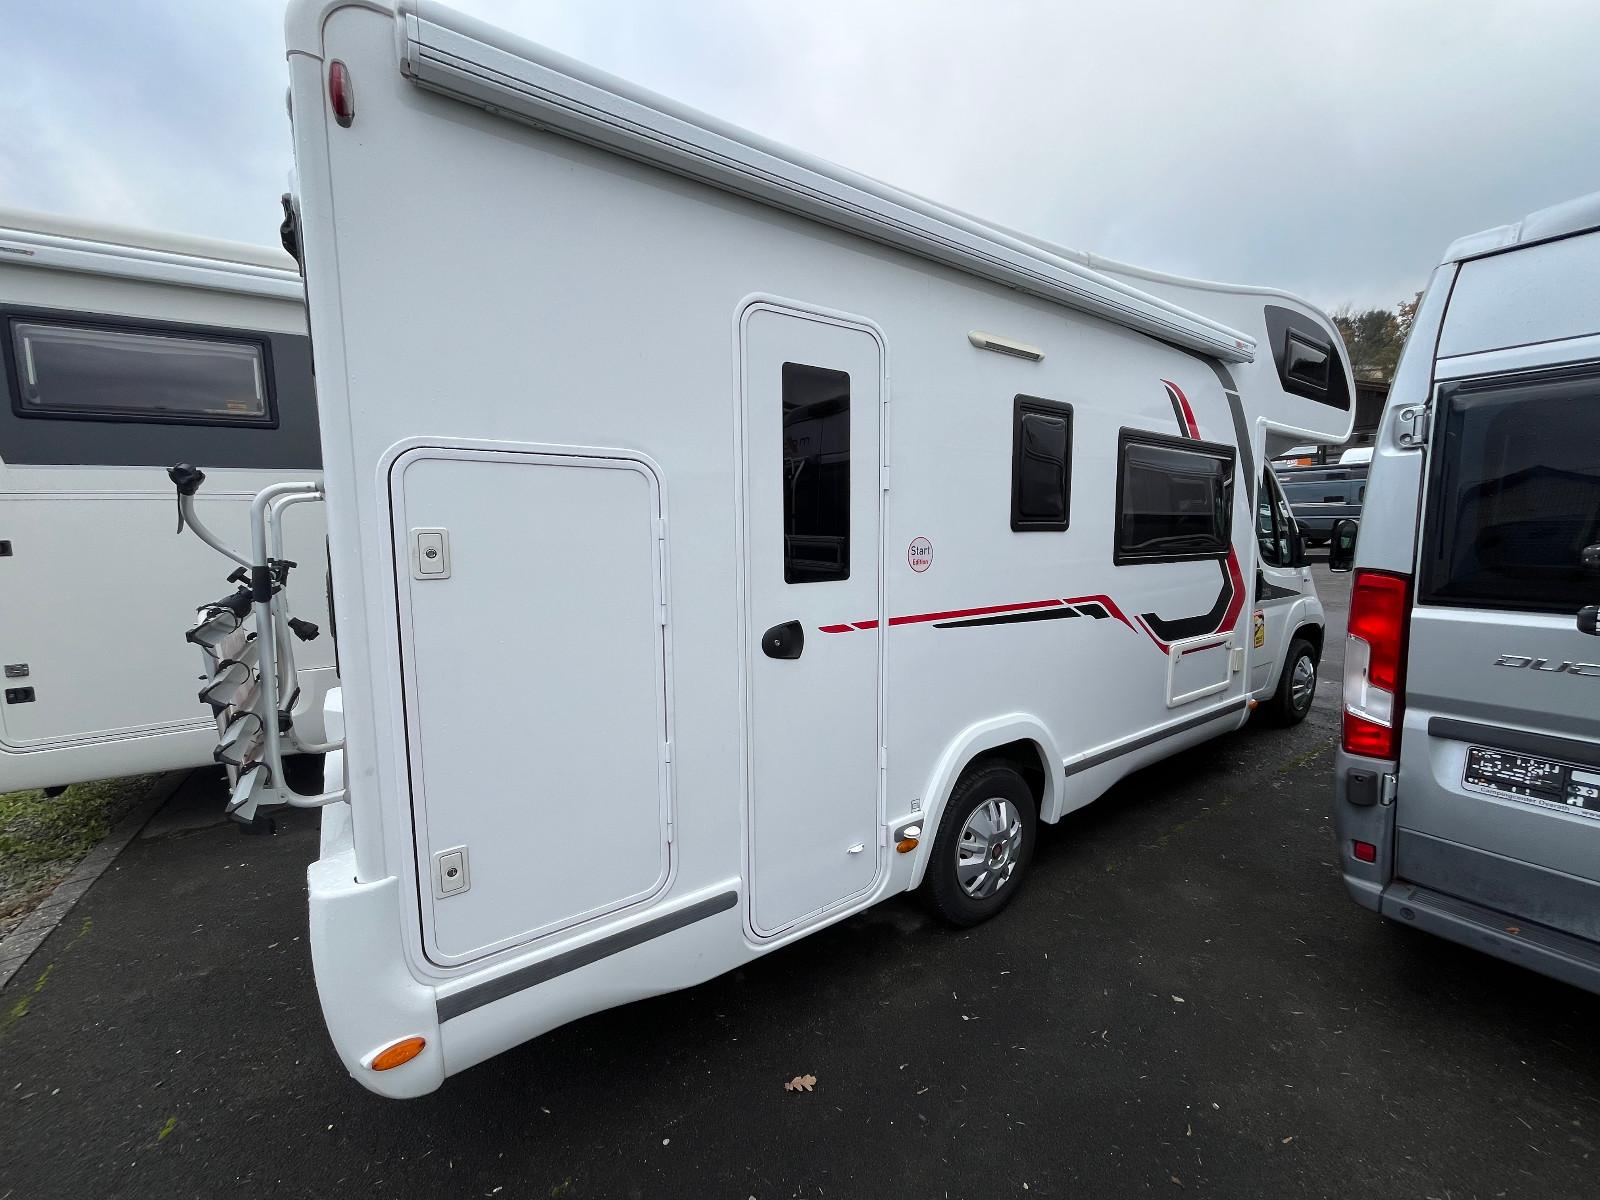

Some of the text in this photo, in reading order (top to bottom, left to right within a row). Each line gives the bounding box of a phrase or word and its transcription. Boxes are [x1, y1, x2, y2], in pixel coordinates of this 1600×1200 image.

[911, 545, 930, 556] Start
[1480, 786, 1536, 804] Campingcenter
[1538, 799, 1570, 812] Overath
